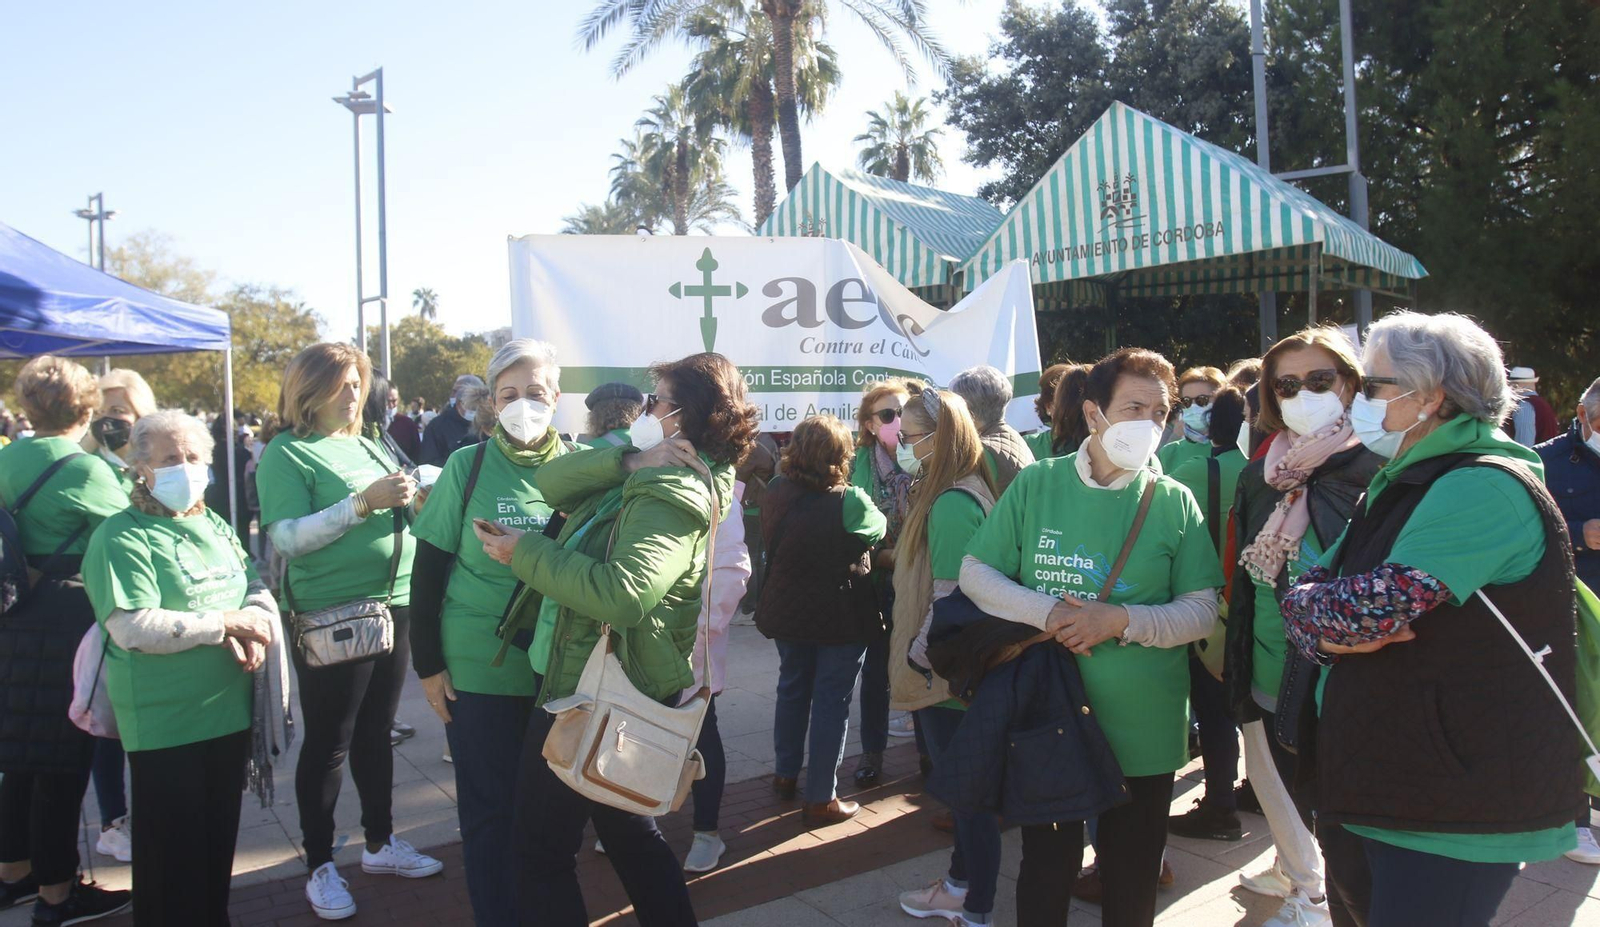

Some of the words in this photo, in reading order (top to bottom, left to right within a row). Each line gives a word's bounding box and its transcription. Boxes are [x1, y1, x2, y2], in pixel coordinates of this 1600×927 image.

[1032, 237, 1128, 267] AYUNTAMIENTO
[1132, 233, 1149, 250] DE
[1153, 221, 1225, 247] CORDOBA
[800, 336, 863, 354] Contra
[869, 338, 885, 354] el
[770, 369, 847, 389] Española
[775, 403, 797, 421] de
[497, 502, 516, 514] En
[1037, 535, 1056, 549] En
[1034, 553, 1094, 570] marcha
[1034, 569, 1083, 585] contra
[1036, 583, 1046, 594] el
[187, 595, 202, 609] el
